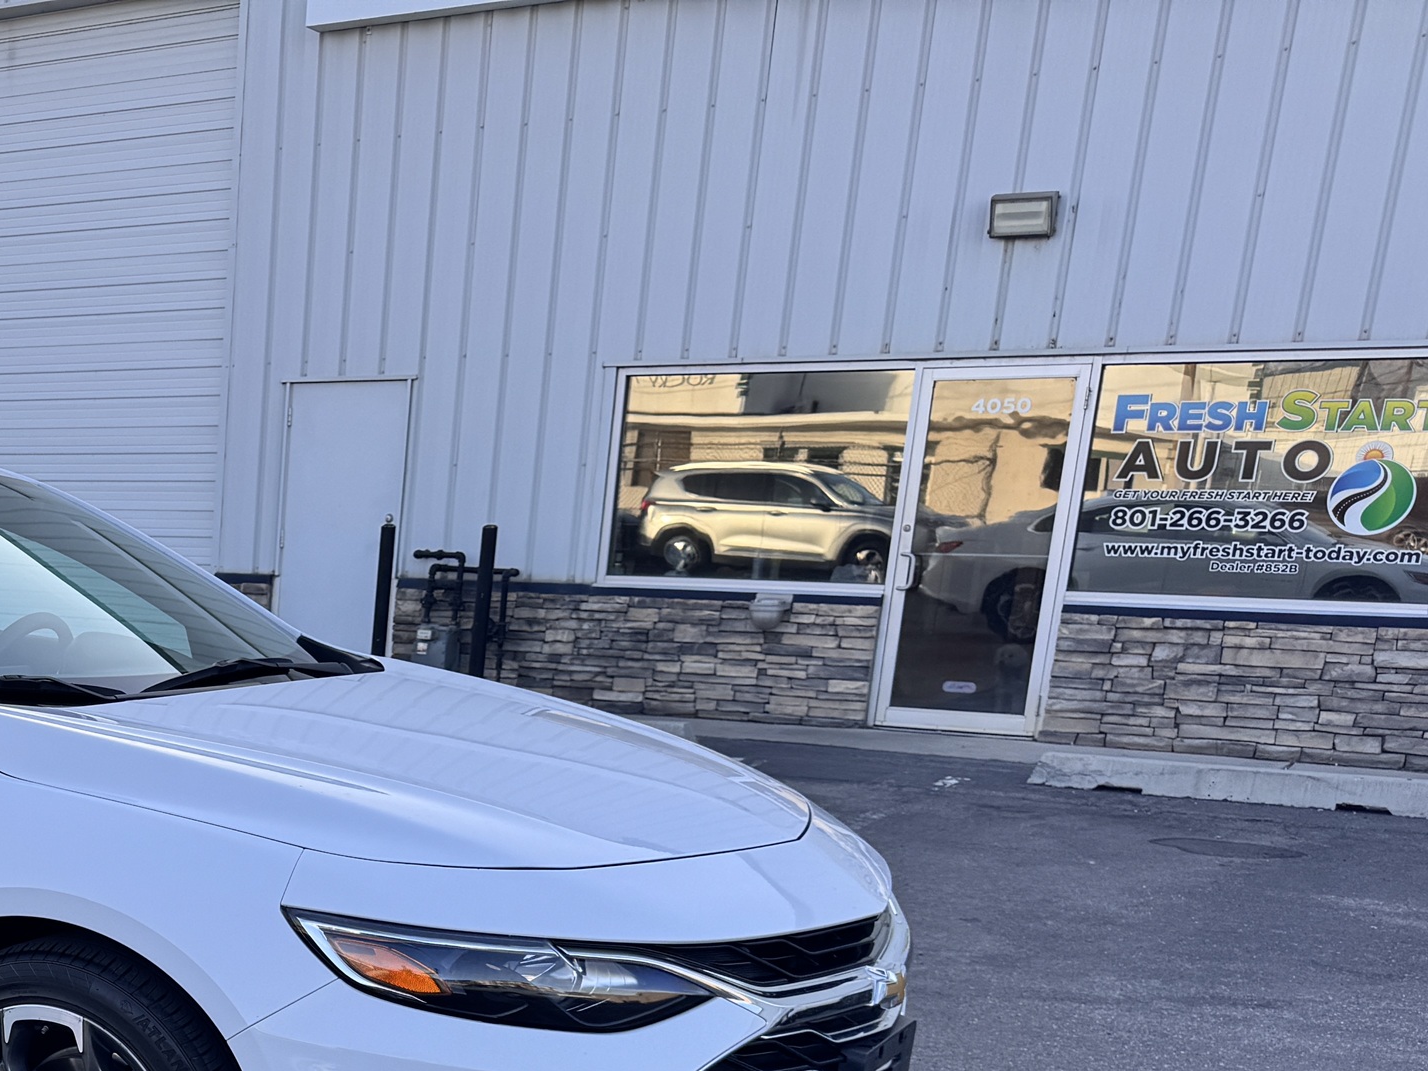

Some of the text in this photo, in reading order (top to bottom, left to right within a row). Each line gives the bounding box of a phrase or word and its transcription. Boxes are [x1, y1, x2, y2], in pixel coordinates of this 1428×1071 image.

[971, 397, 1032, 415] 4050
[1112, 394, 1269, 433] FRESH
[1113, 439, 1334, 483] AUTO
[1114, 490, 1317, 502] GET YOUR FRESH START HERE!
[1109, 507, 1309, 532] 801-266-3266
[1104, 541, 1422, 565] www.myfreshstart-today.com
[1209, 561, 1299, 574] Dealer #852B
